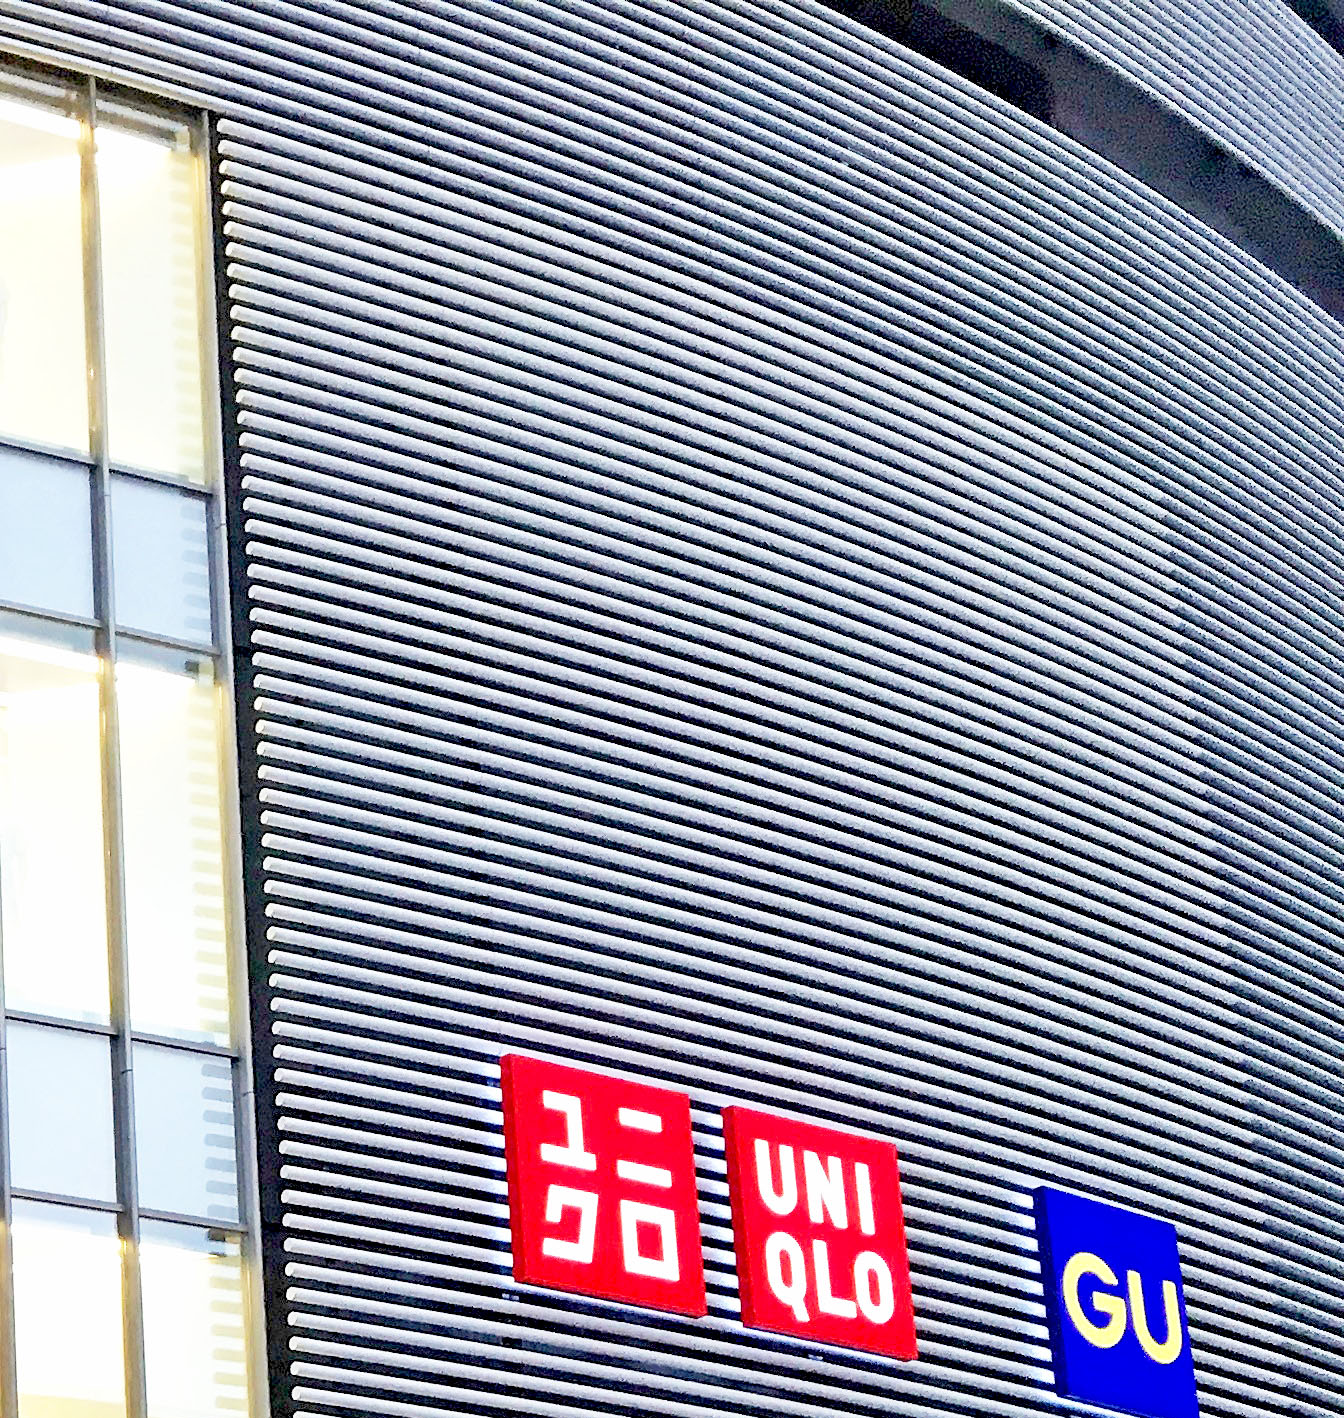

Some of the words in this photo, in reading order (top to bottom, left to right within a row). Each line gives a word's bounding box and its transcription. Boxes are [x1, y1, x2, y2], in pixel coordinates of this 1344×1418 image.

[754, 1139, 878, 1236] UNI
[764, 1230, 895, 1325] QLO
[1062, 1251, 1184, 1365] GU
